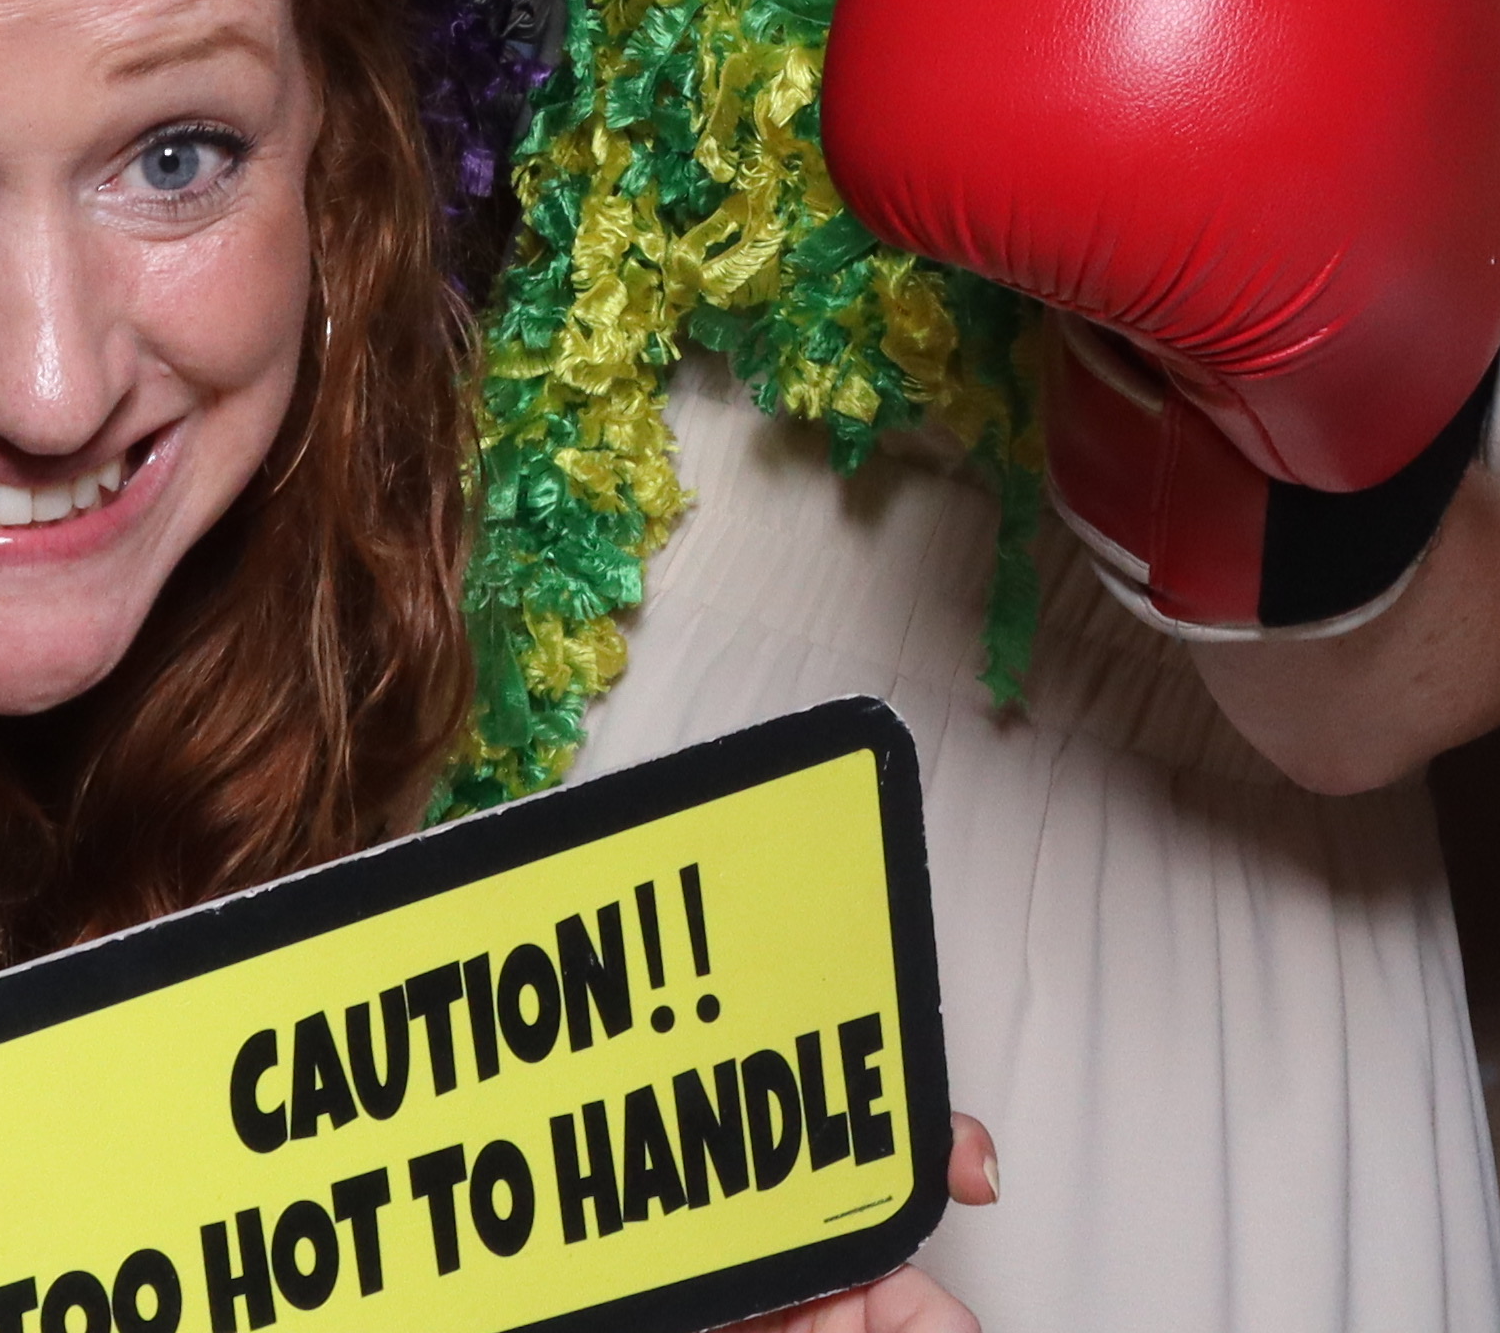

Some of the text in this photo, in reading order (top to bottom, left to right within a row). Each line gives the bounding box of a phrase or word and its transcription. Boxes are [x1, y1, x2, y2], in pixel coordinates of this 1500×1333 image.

[229, 862, 722, 1155] CAUTION!!
[200, 1166, 393, 1333] HOT
[407, 1139, 537, 1277] TO
[549, 1011, 897, 1245] HANDLE
